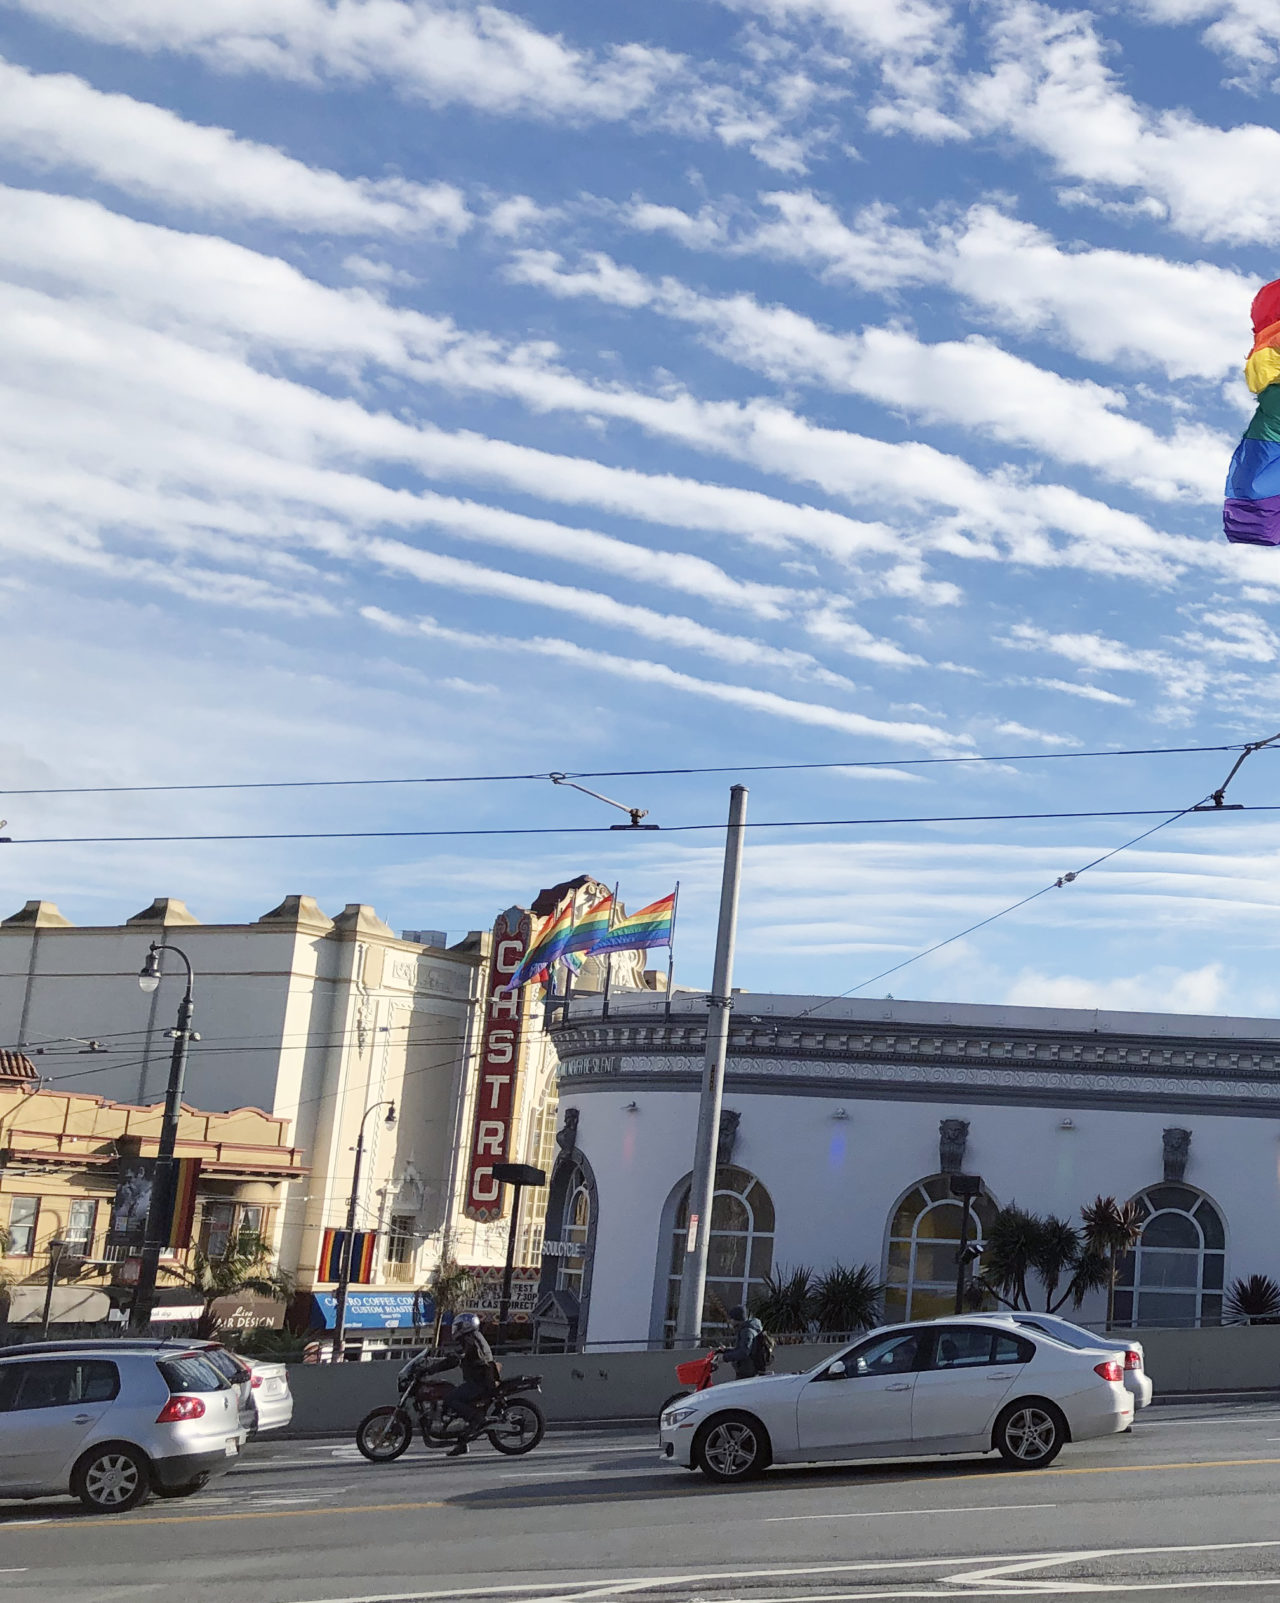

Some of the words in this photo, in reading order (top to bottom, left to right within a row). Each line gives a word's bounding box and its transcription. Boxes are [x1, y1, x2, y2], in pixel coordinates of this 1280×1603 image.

[472, 940, 524, 1201] CASTRO
[541, 1240, 580, 1257] SOULCYCLE
[325, 1297, 361, 1306] CARO
[363, 1297, 397, 1306] COFFEE
[351, 1305, 383, 1314] CUSTOM
[237, 1317, 275, 1328] DESIGN
